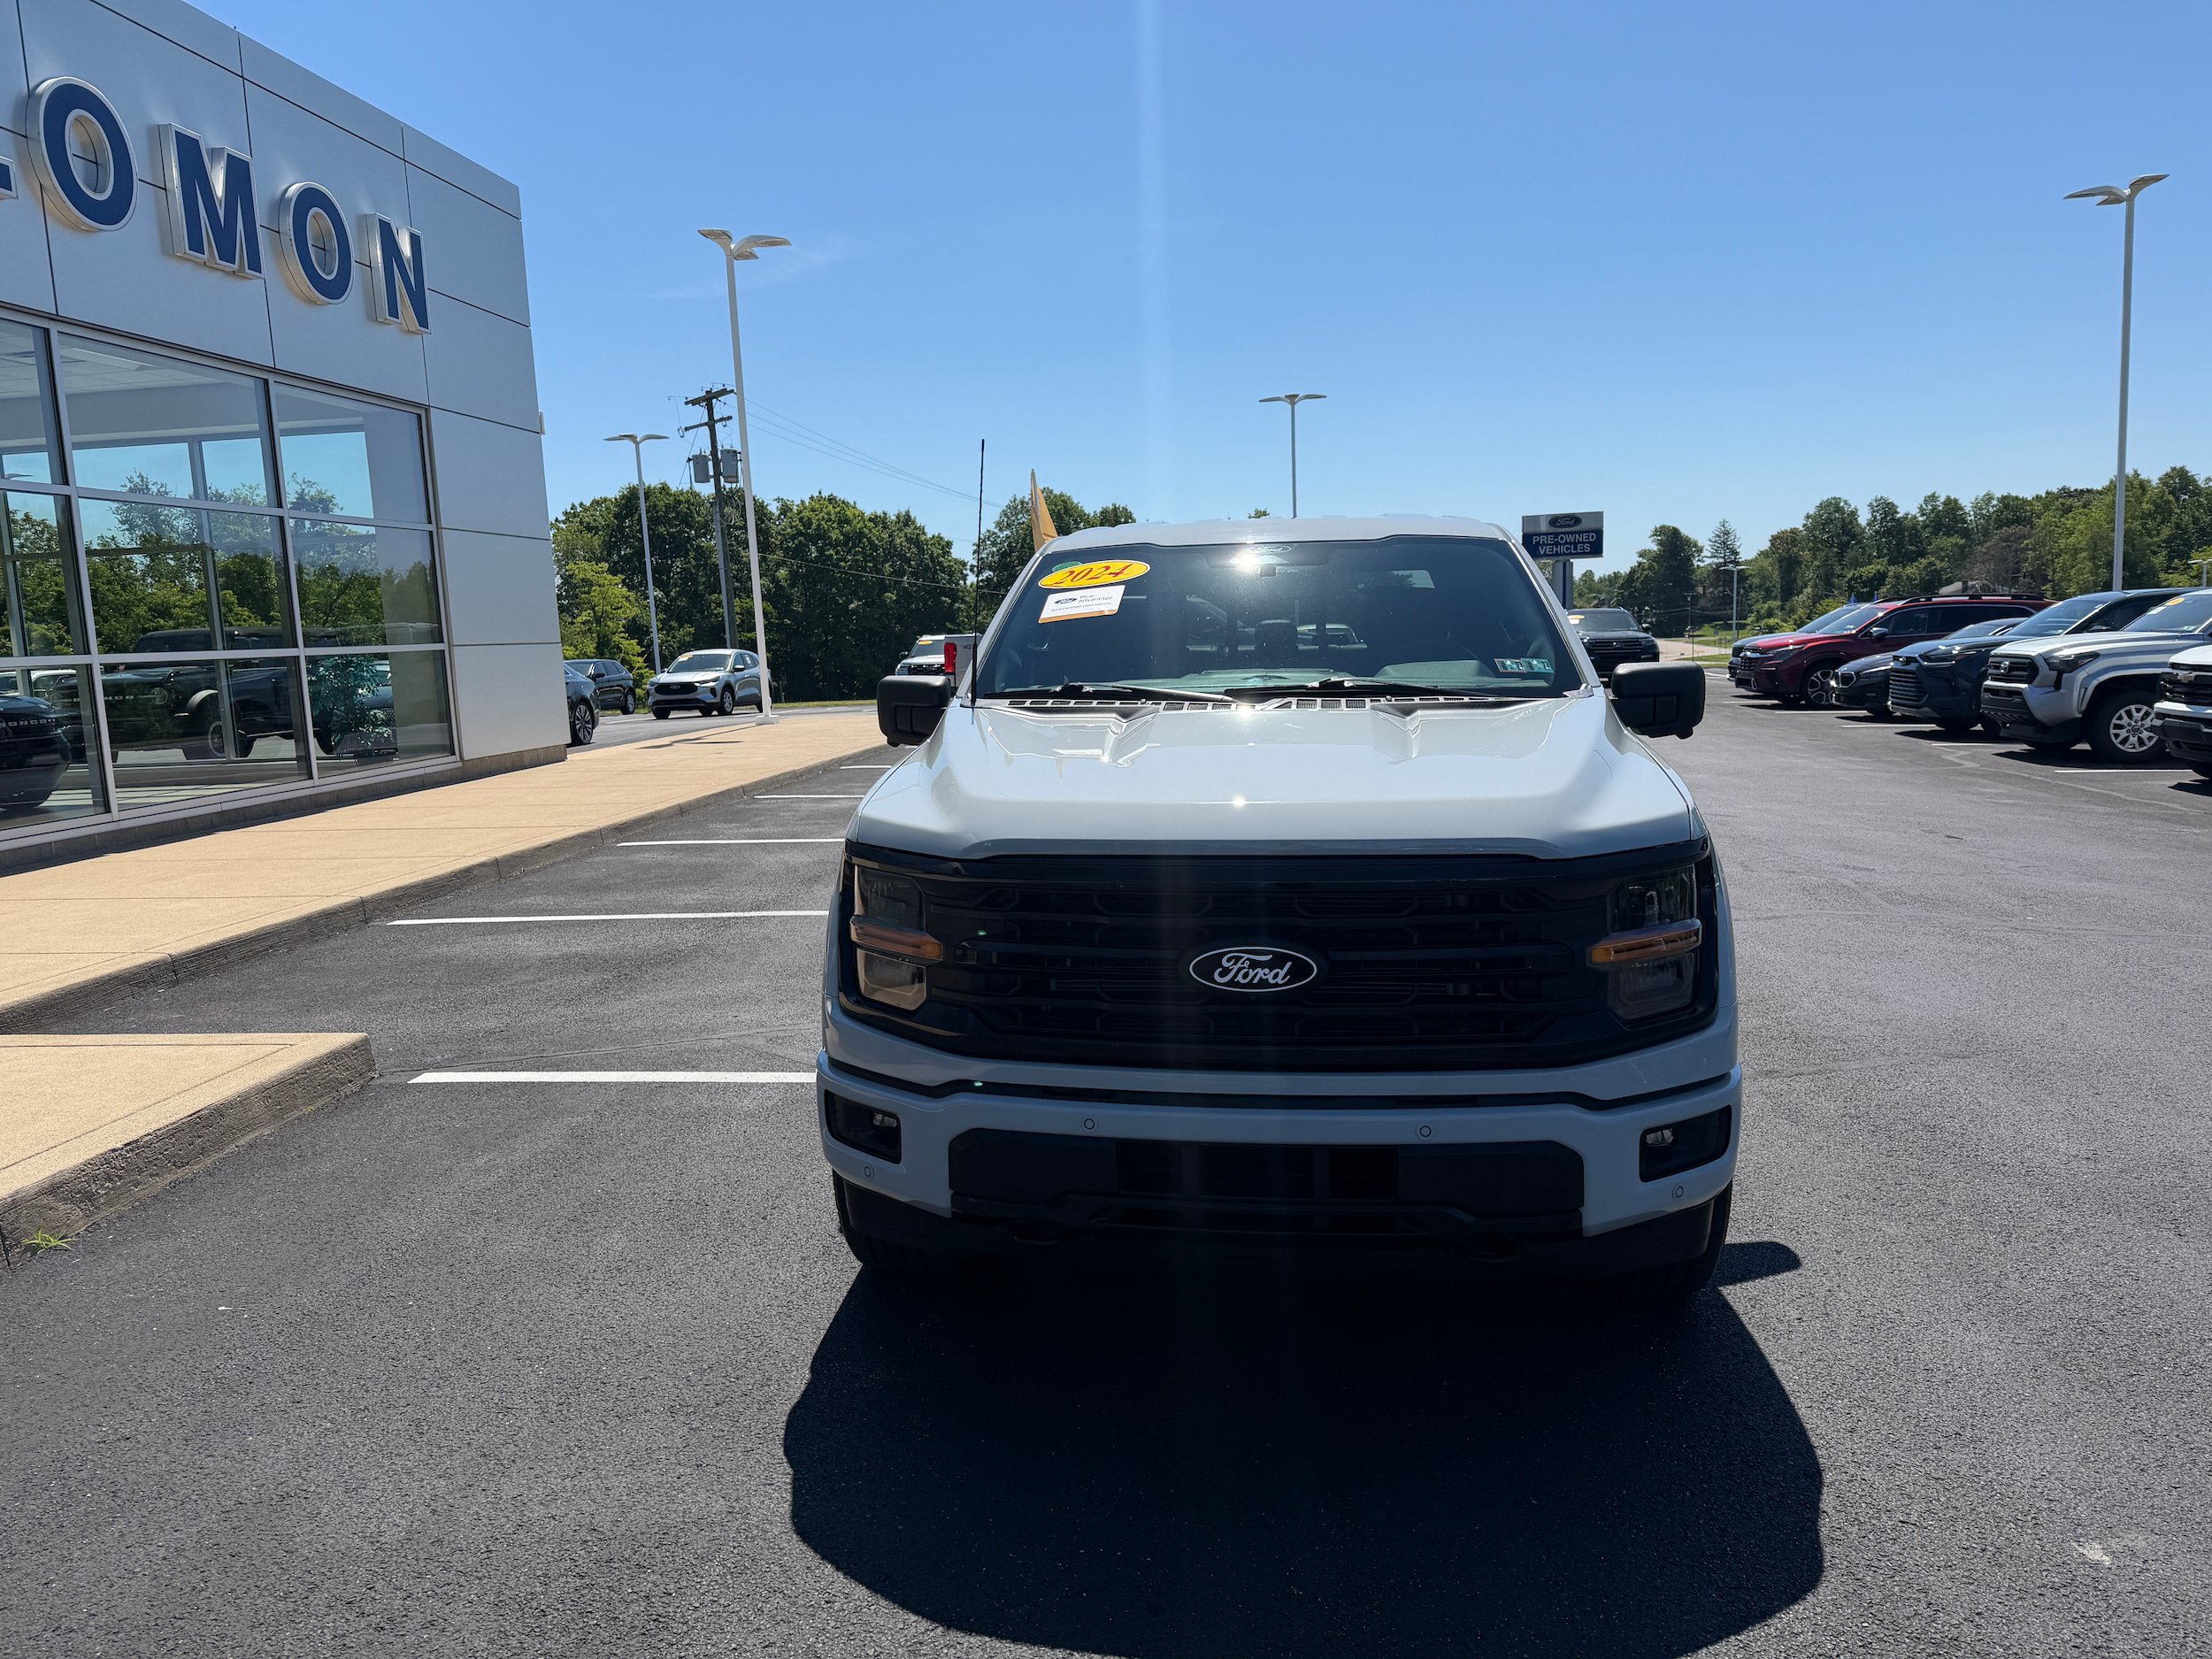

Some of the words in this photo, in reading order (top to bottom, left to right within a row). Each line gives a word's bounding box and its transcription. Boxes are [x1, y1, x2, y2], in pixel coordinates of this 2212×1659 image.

[0, 76, 432, 334] OMON
[1532, 533, 1596, 544] PRE-OWNED
[1539, 543, 1591, 555] VEHICLES
[1052, 563, 1133, 585] 2024
[1213, 952, 1293, 985] Ford
